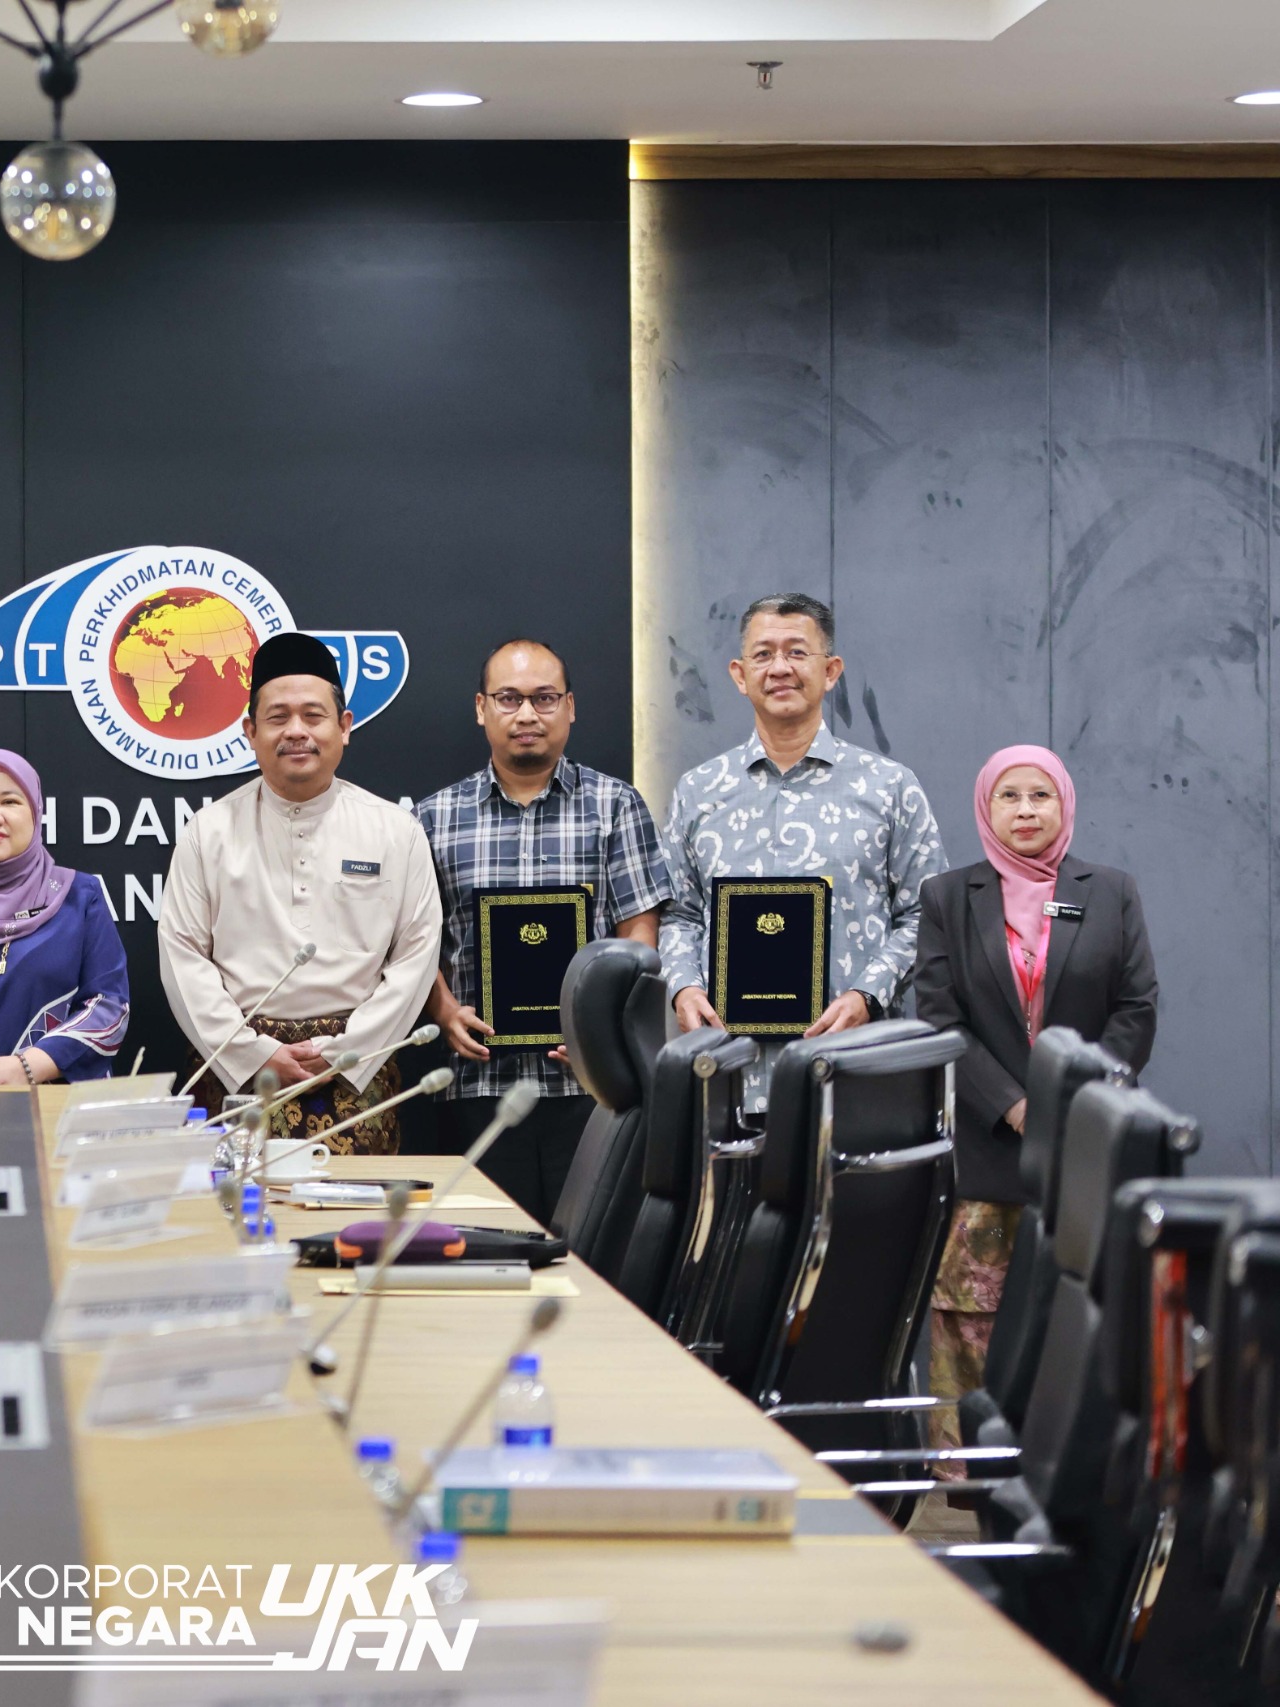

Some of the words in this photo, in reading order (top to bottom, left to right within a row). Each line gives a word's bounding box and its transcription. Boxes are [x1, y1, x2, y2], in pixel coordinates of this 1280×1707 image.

[79, 559, 215, 662] PERKHIDMATAN
[221, 569, 283, 634] CEMER
[80, 678, 199, 770] DIUTAMAKAN
